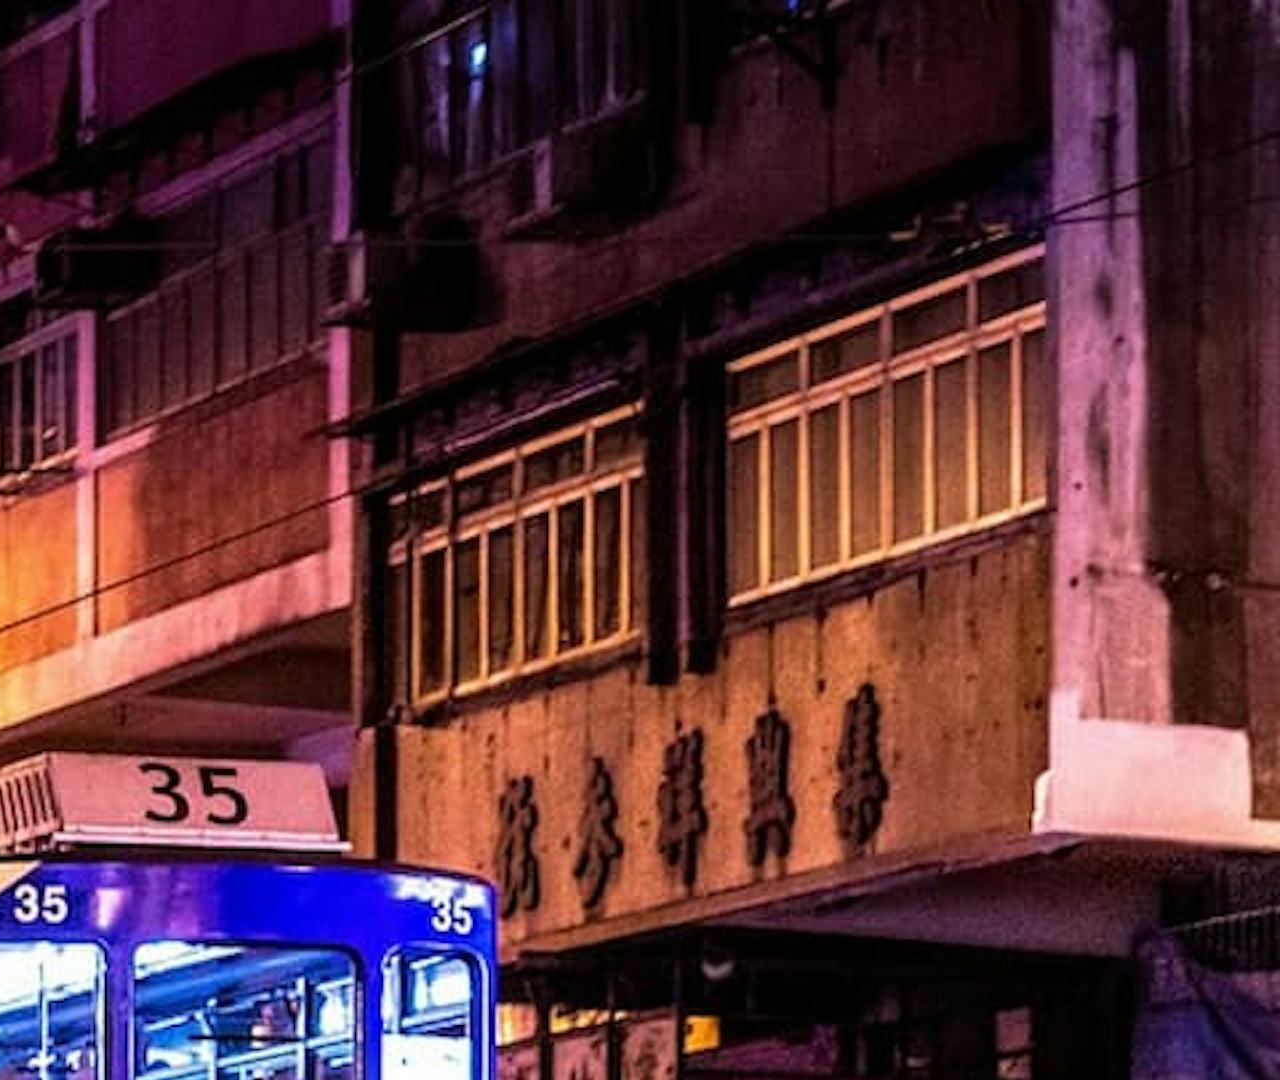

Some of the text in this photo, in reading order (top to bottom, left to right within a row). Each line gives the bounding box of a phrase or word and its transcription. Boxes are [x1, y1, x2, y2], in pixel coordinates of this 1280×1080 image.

[138, 762, 251, 826] 35
[13, 885, 69, 924] 35
[430, 898, 474, 935] 35
